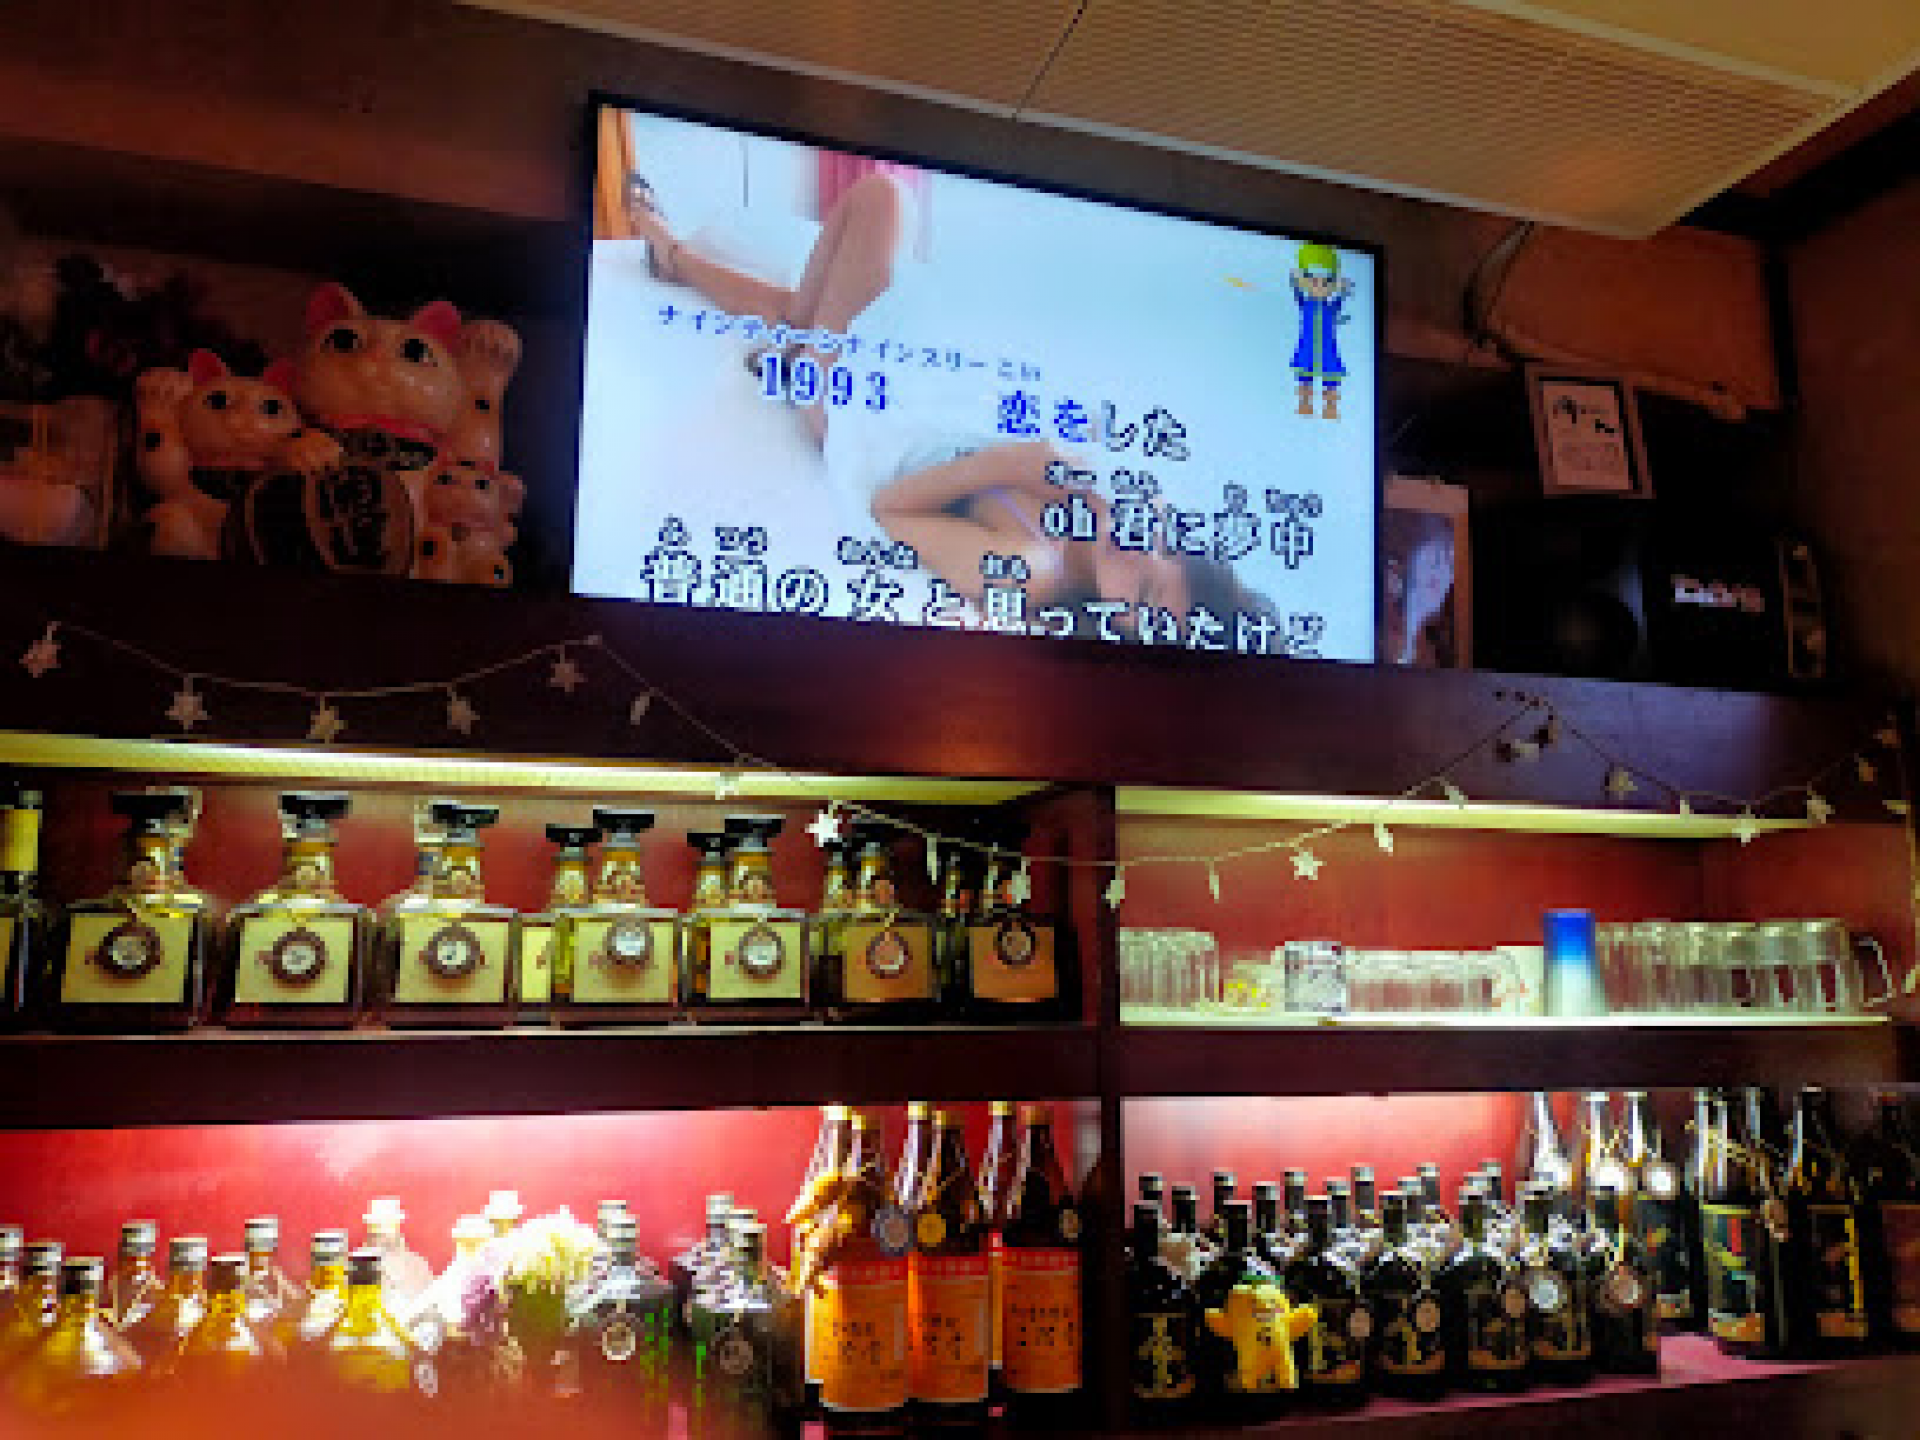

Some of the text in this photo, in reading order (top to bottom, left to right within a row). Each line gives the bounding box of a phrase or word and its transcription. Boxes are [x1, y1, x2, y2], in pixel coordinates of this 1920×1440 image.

[760, 354, 1192, 461] 1993 恋をした
[1039, 493, 1315, 570] oh 君に夢中
[639, 549, 1325, 656] 普通の女と思っていたけど
